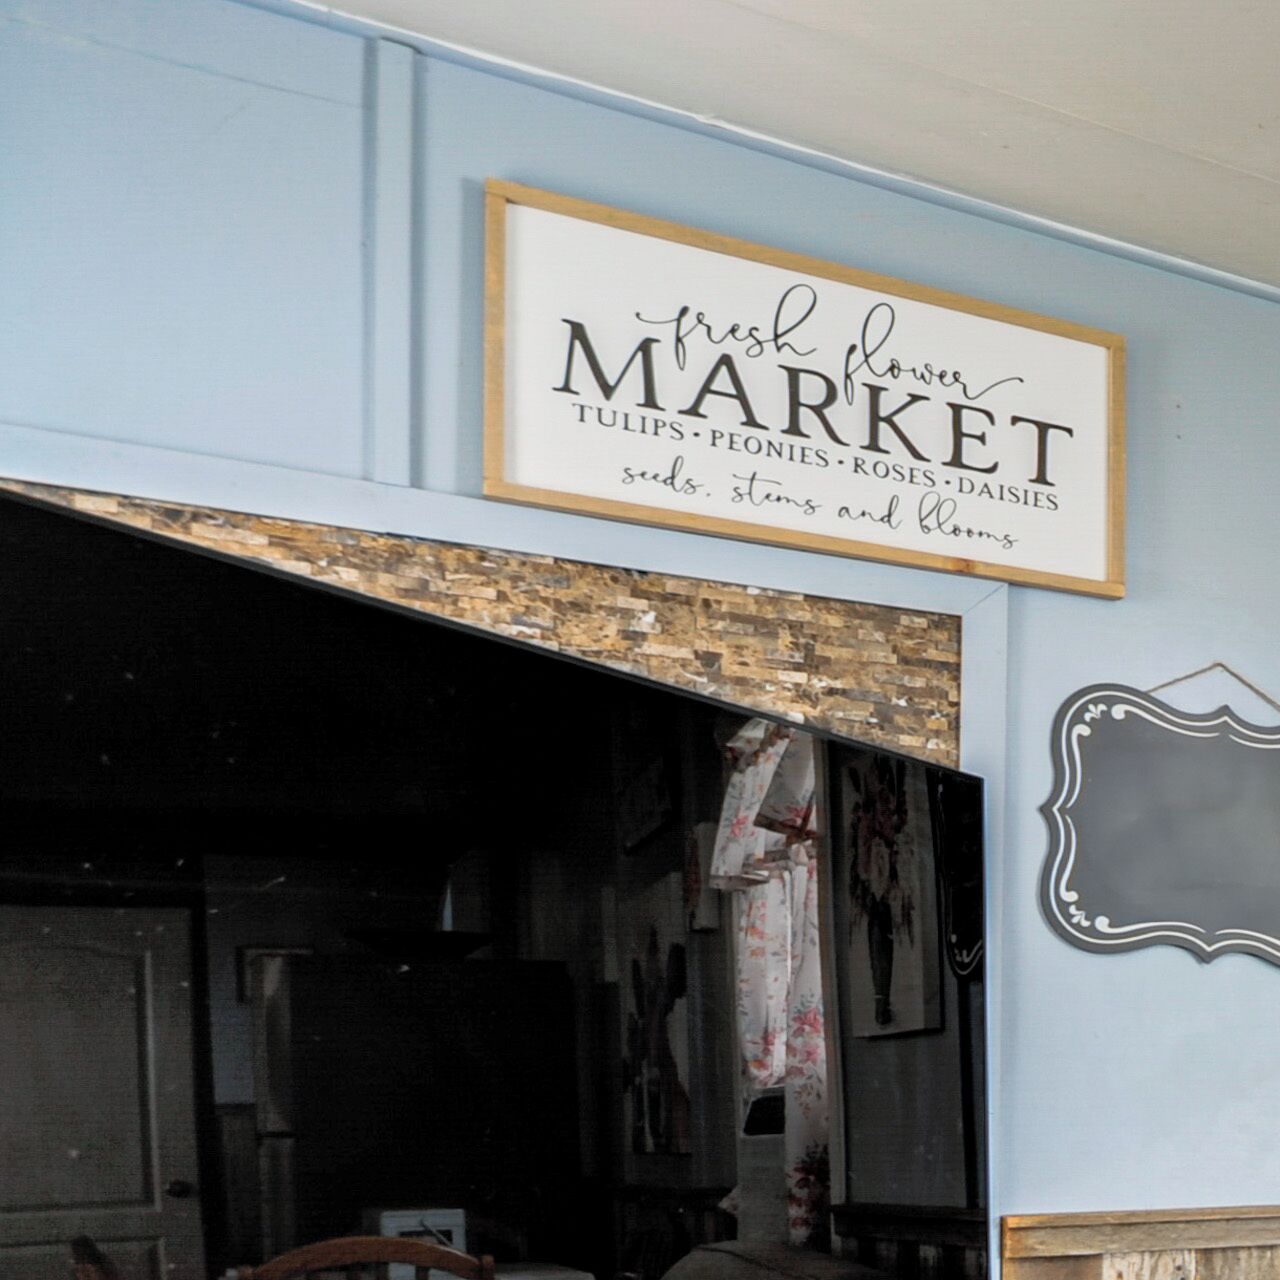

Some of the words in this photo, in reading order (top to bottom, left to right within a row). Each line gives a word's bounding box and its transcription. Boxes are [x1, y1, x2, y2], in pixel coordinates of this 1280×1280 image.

[552, 318, 1075, 488] MARKET
[635, 284, 817, 371] fresh
[843, 302, 1024, 407] flower
[571, 401, 685, 442] TULIPS
[709, 429, 830, 470] PEONIES
[851, 456, 937, 489] ROSES
[956, 475, 1061, 512] DAISIES
[730, 471, 823, 516] stems
[837, 493, 902, 532] and
[918, 491, 1020, 550] blooms
